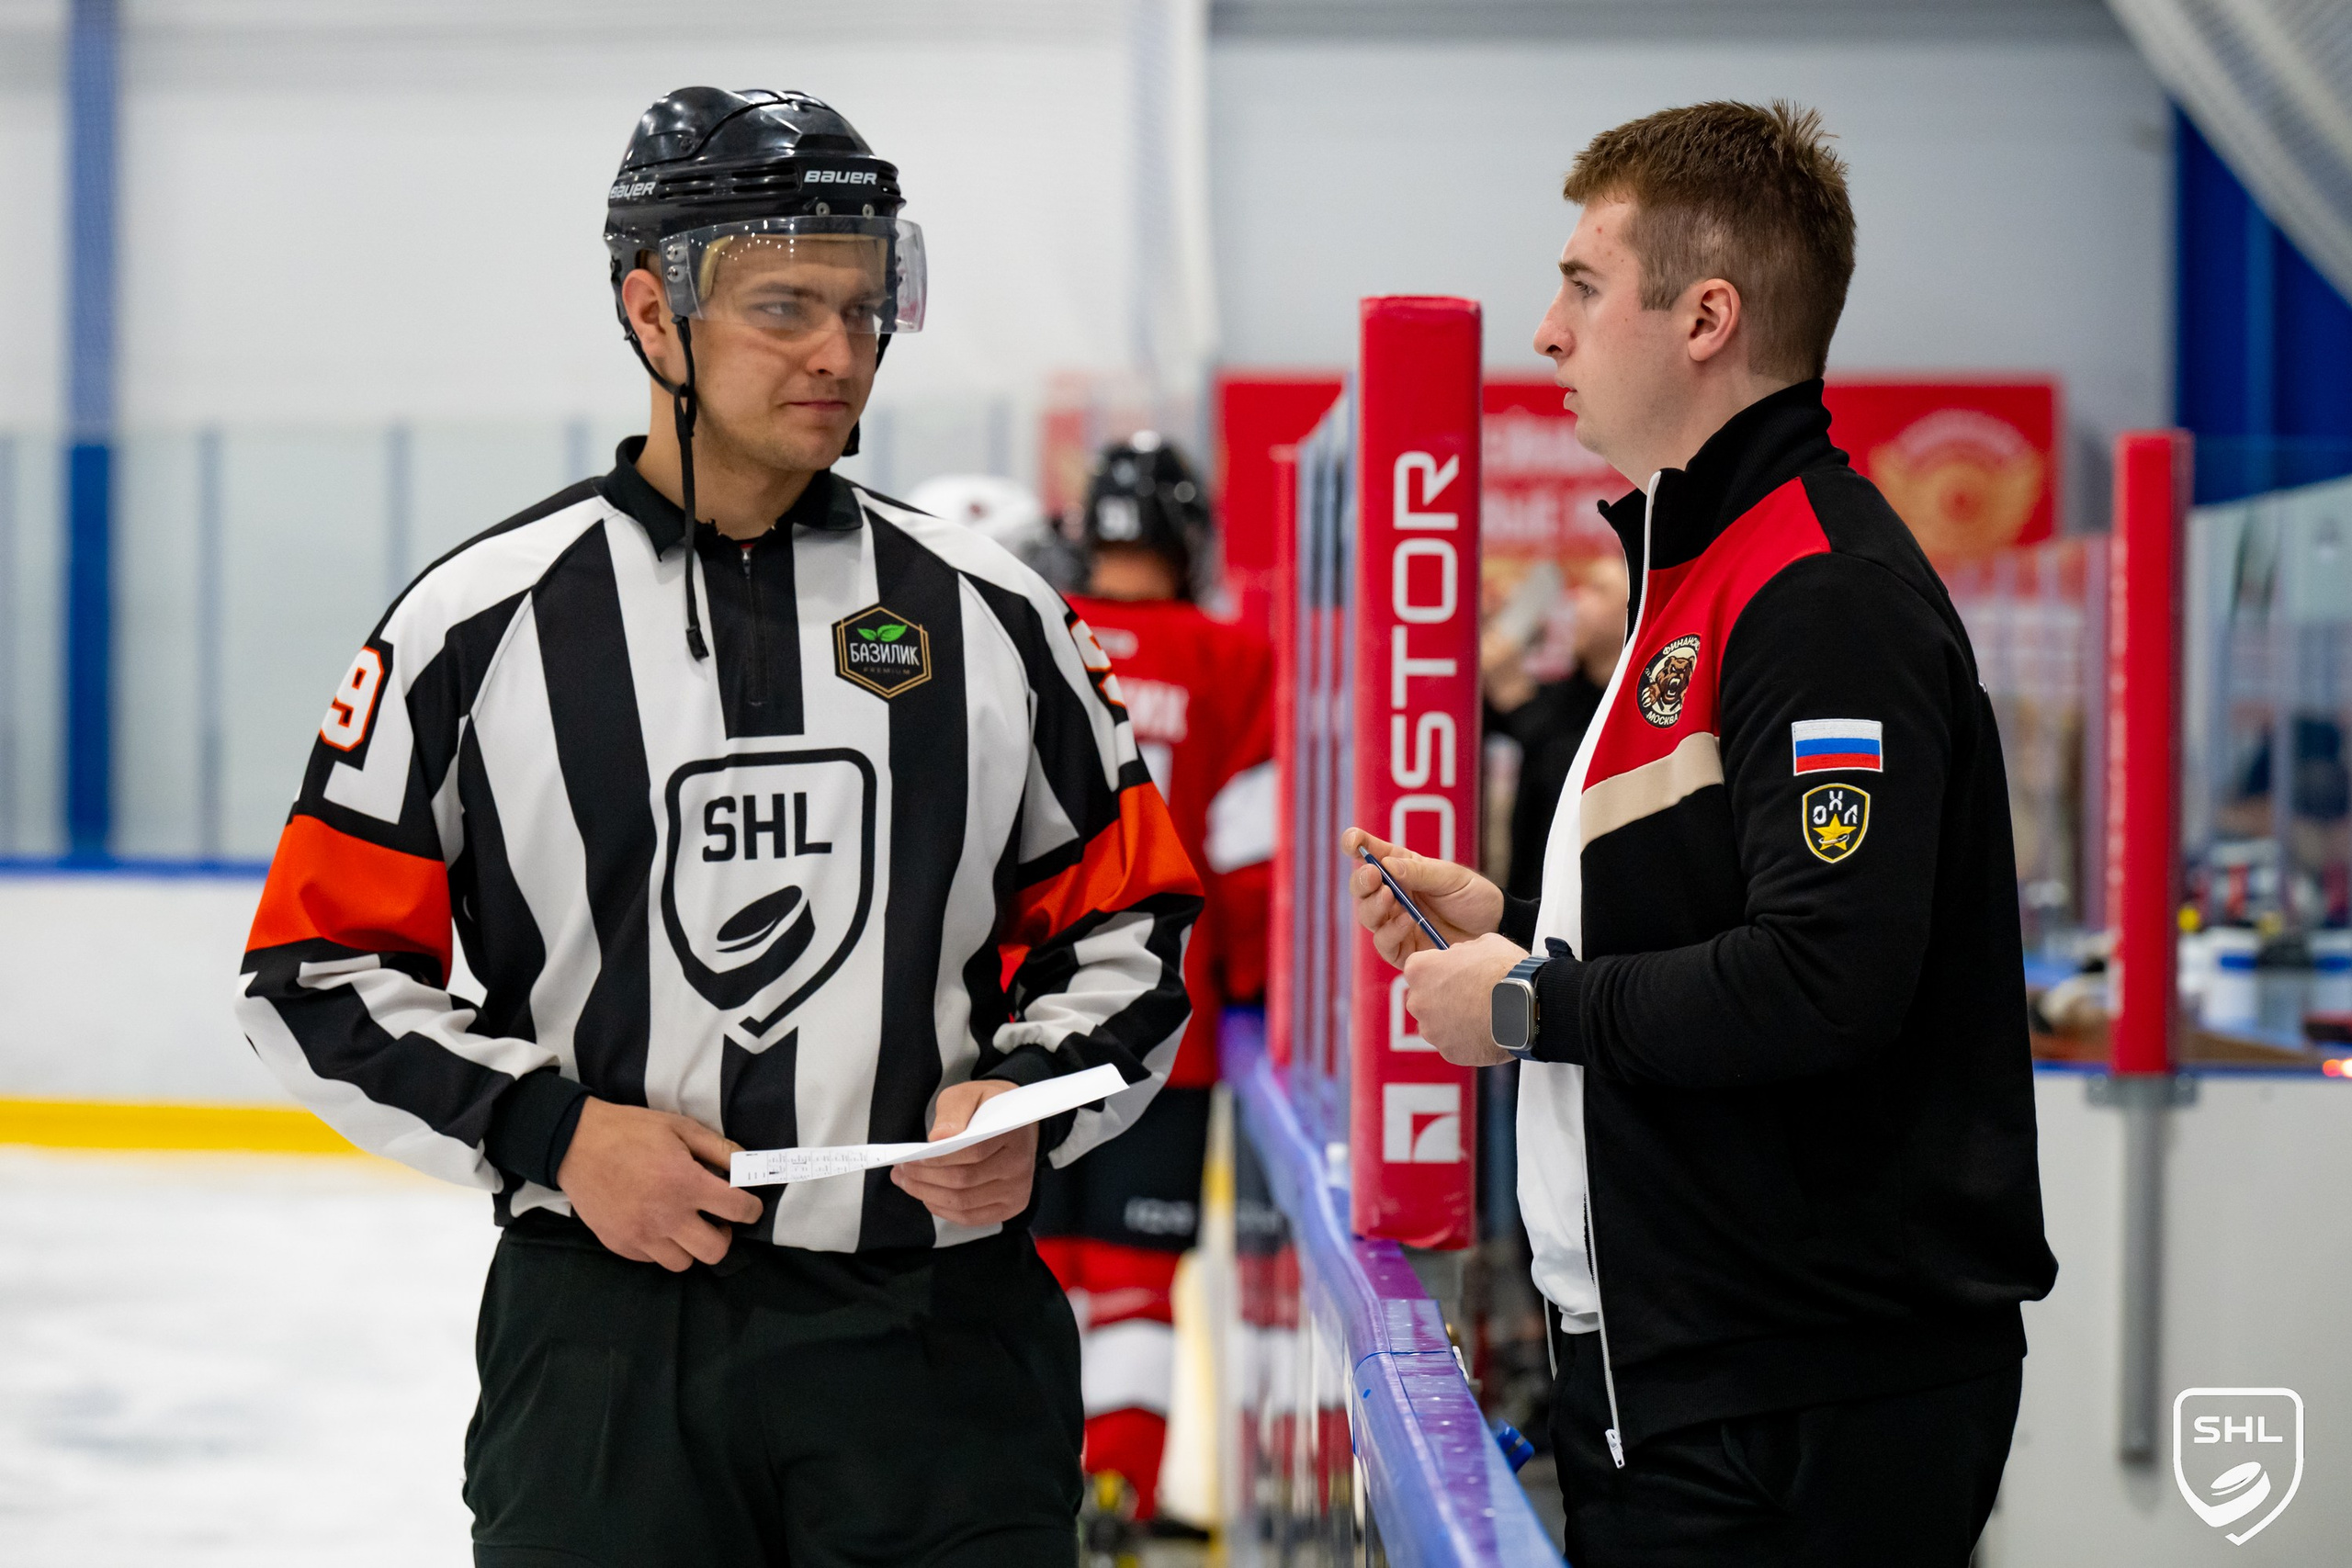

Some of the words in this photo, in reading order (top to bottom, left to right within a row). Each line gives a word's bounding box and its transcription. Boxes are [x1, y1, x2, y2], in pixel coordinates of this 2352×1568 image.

[804, 170, 877, 185] BAUER
[850, 643, 920, 666] БАЗИЛИК
[319, 646, 385, 752] 9
[1645, 711, 1679, 726] МОСКВА
[702, 792, 832, 863] SHL
